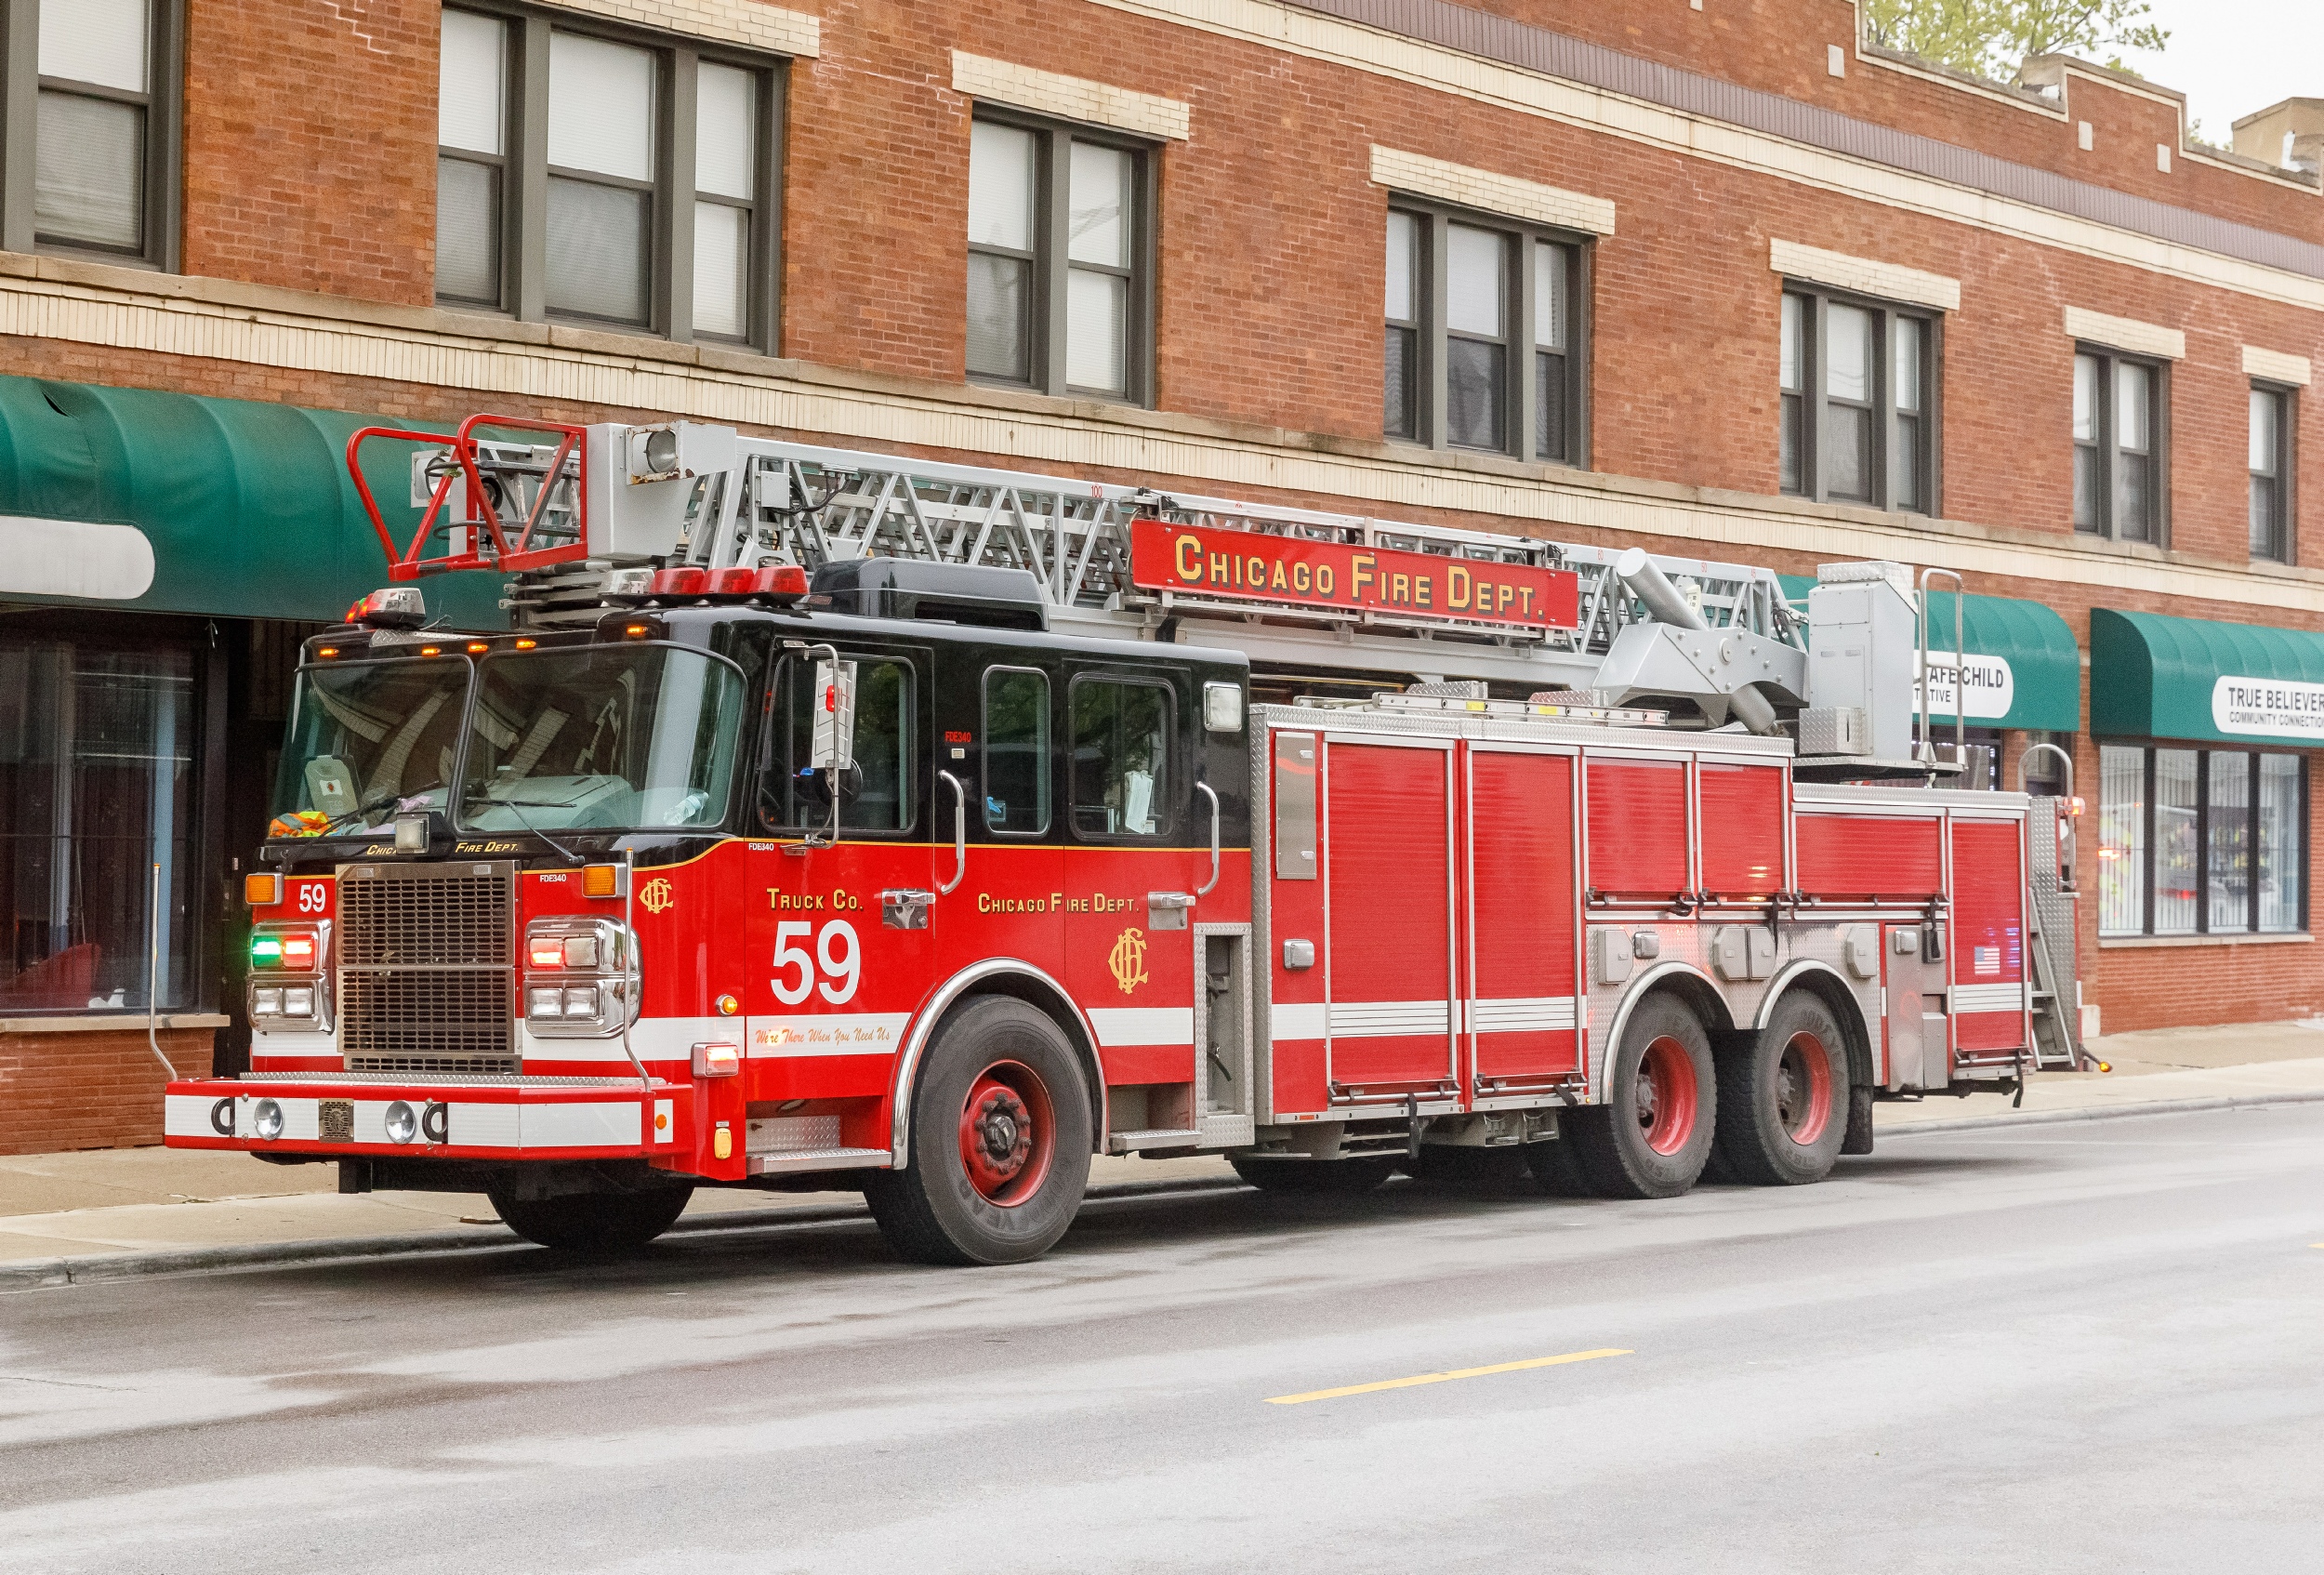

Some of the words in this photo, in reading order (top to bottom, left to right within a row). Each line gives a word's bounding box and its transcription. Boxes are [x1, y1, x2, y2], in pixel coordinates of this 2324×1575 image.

[1090, 484, 1103, 498] 100
[1175, 535, 1335, 596] CHICAGO
[1352, 554, 1433, 606] FIRE
[1447, 565, 1543, 617] DEPT.
[1929, 668, 1957, 684] AFE
[1962, 666, 2003, 688] CHILD
[2228, 687, 2262, 708] TRUE
[2229, 711, 2277, 725] COMMUNITY
[944, 731, 971, 743] FDE340
[366, 844, 397, 855] CHIC
[455, 842, 482, 854] FIRE
[484, 841, 519, 853] DEPT.
[748, 842, 774, 852] FDE340
[539, 874, 566, 882] FDE340
[298, 883, 325, 912] 59
[766, 888, 825, 910] TRUCK
[833, 889, 864, 910] CO.
[978, 893, 1045, 913] CHICAGO
[1050, 893, 1089, 912] FIRE
[1093, 893, 1140, 912] DEPT.
[770, 920, 861, 1005] 59
[782, 1028, 805, 1043] There
[808, 1028, 830, 1042] When
[835, 1027, 851, 1046] You
[853, 1026, 875, 1042] Need
[877, 1026, 890, 1041] Us
